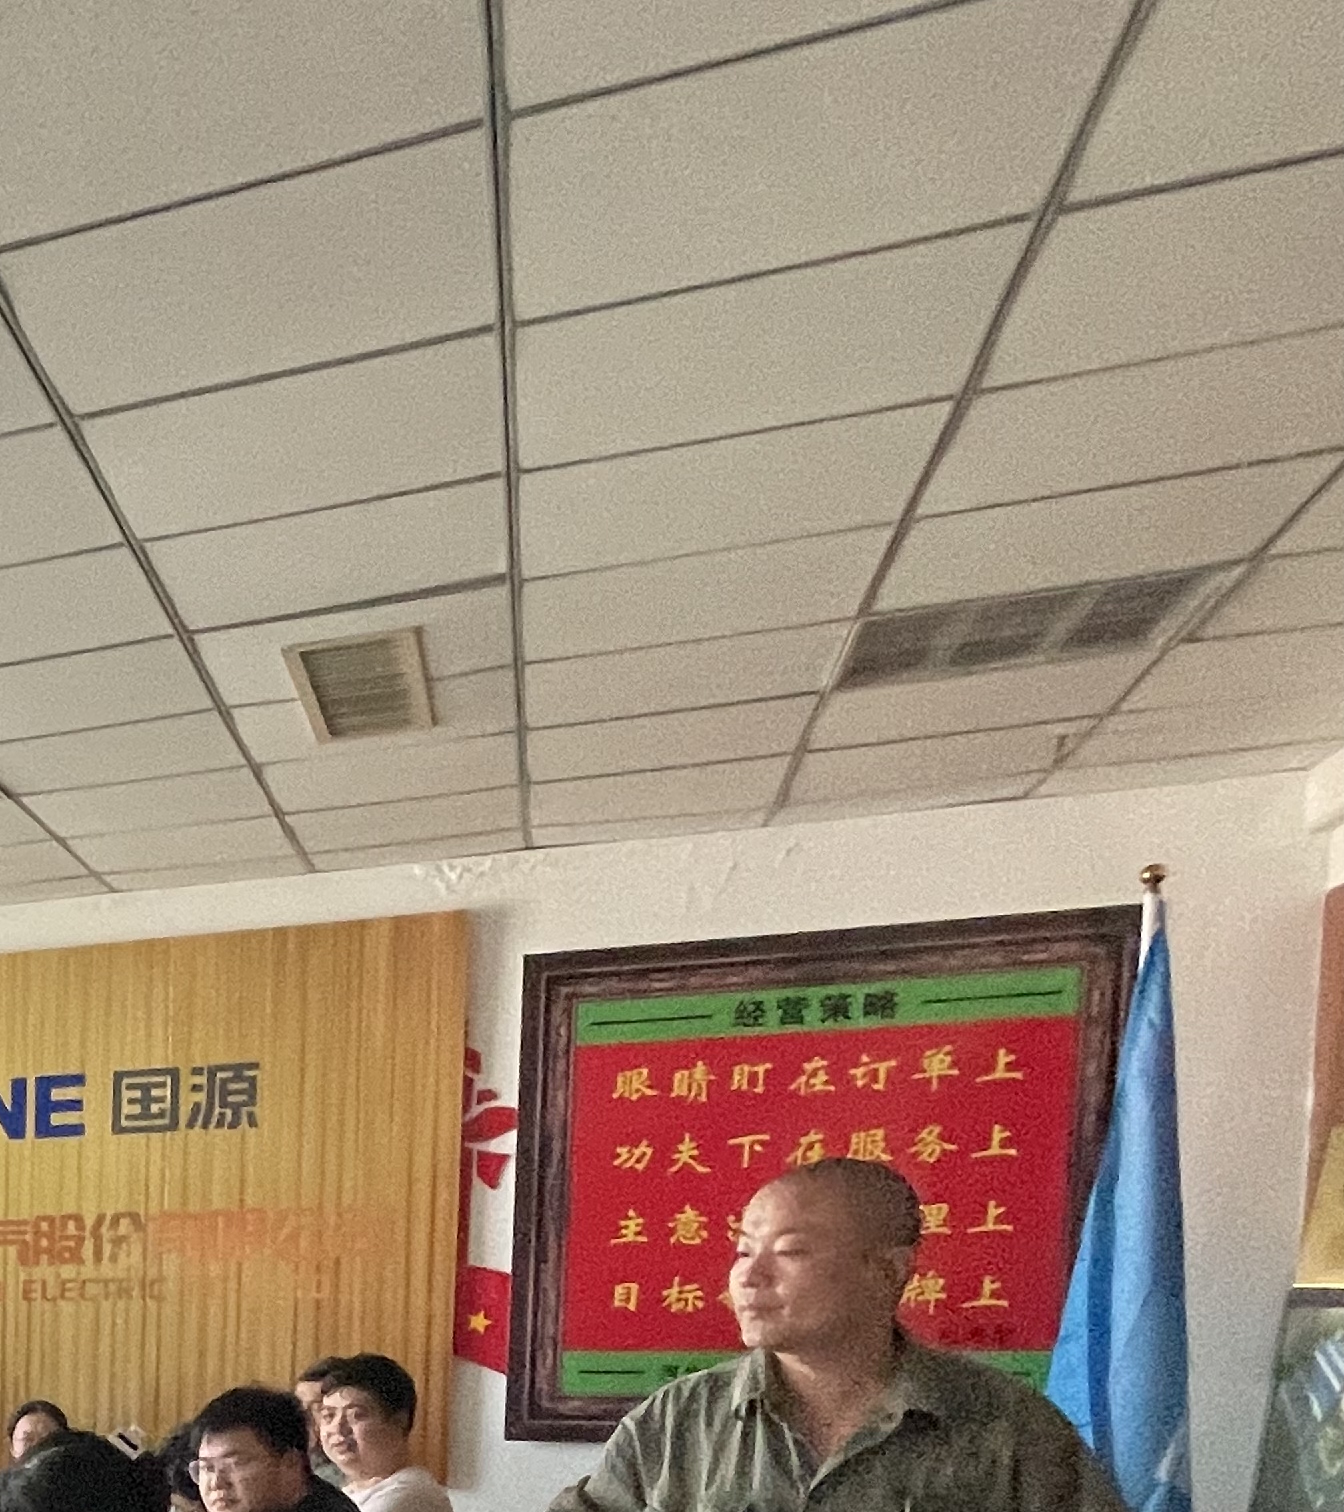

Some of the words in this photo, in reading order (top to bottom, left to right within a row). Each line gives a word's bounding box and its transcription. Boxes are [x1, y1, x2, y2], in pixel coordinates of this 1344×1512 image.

[733, 989, 899, 1028] 经营策略
[111, 1061, 261, 1136] 国源
[611, 1045, 1024, 1102] 眼睛盯在订单上
[612, 1124, 1019, 1174] 功夫下在服务上
